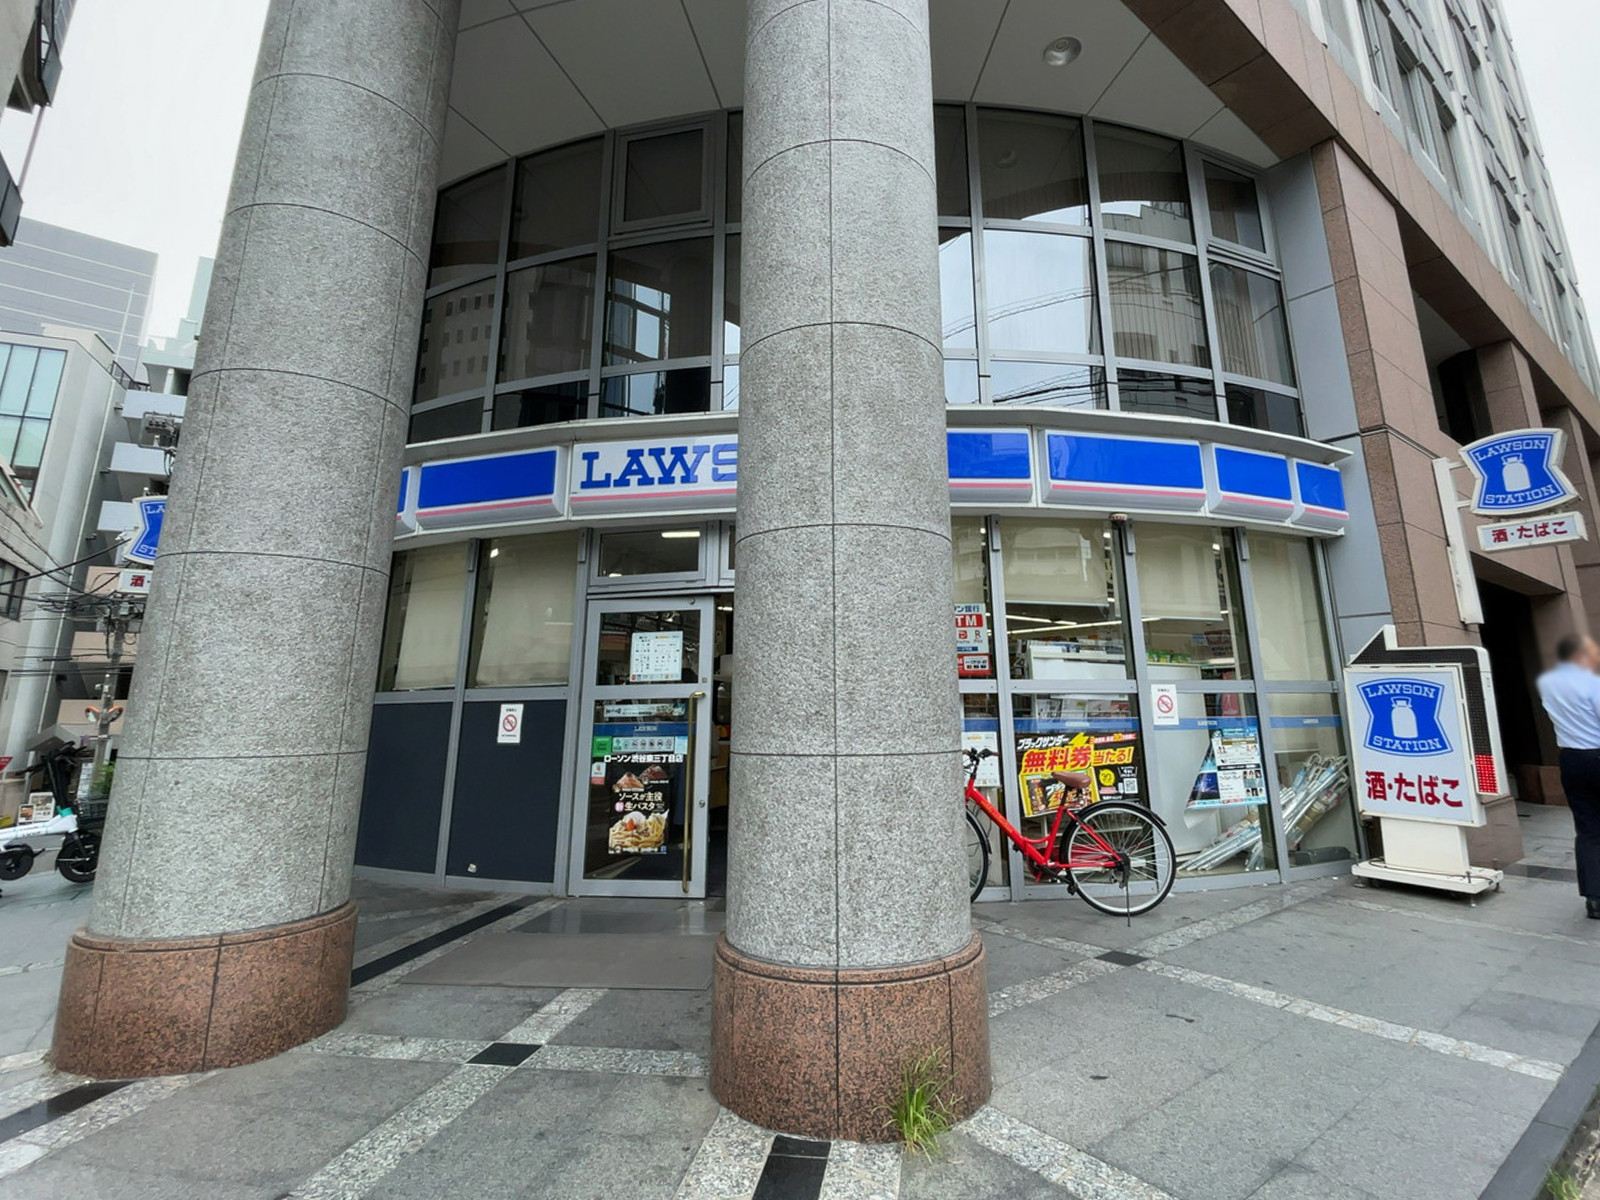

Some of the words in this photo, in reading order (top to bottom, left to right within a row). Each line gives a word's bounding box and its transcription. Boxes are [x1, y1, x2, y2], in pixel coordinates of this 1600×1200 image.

[1474, 439, 1546, 461] LAWSON
[580, 443, 738, 489] LAWS
[1485, 484, 1556, 504] STATION
[1492, 521, 1567, 543] 酒・たばこ
[1365, 683, 1436, 699] LAWSON
[1373, 735, 1443, 752] STATION
[1365, 770, 1463, 808] 酒・たばこ
